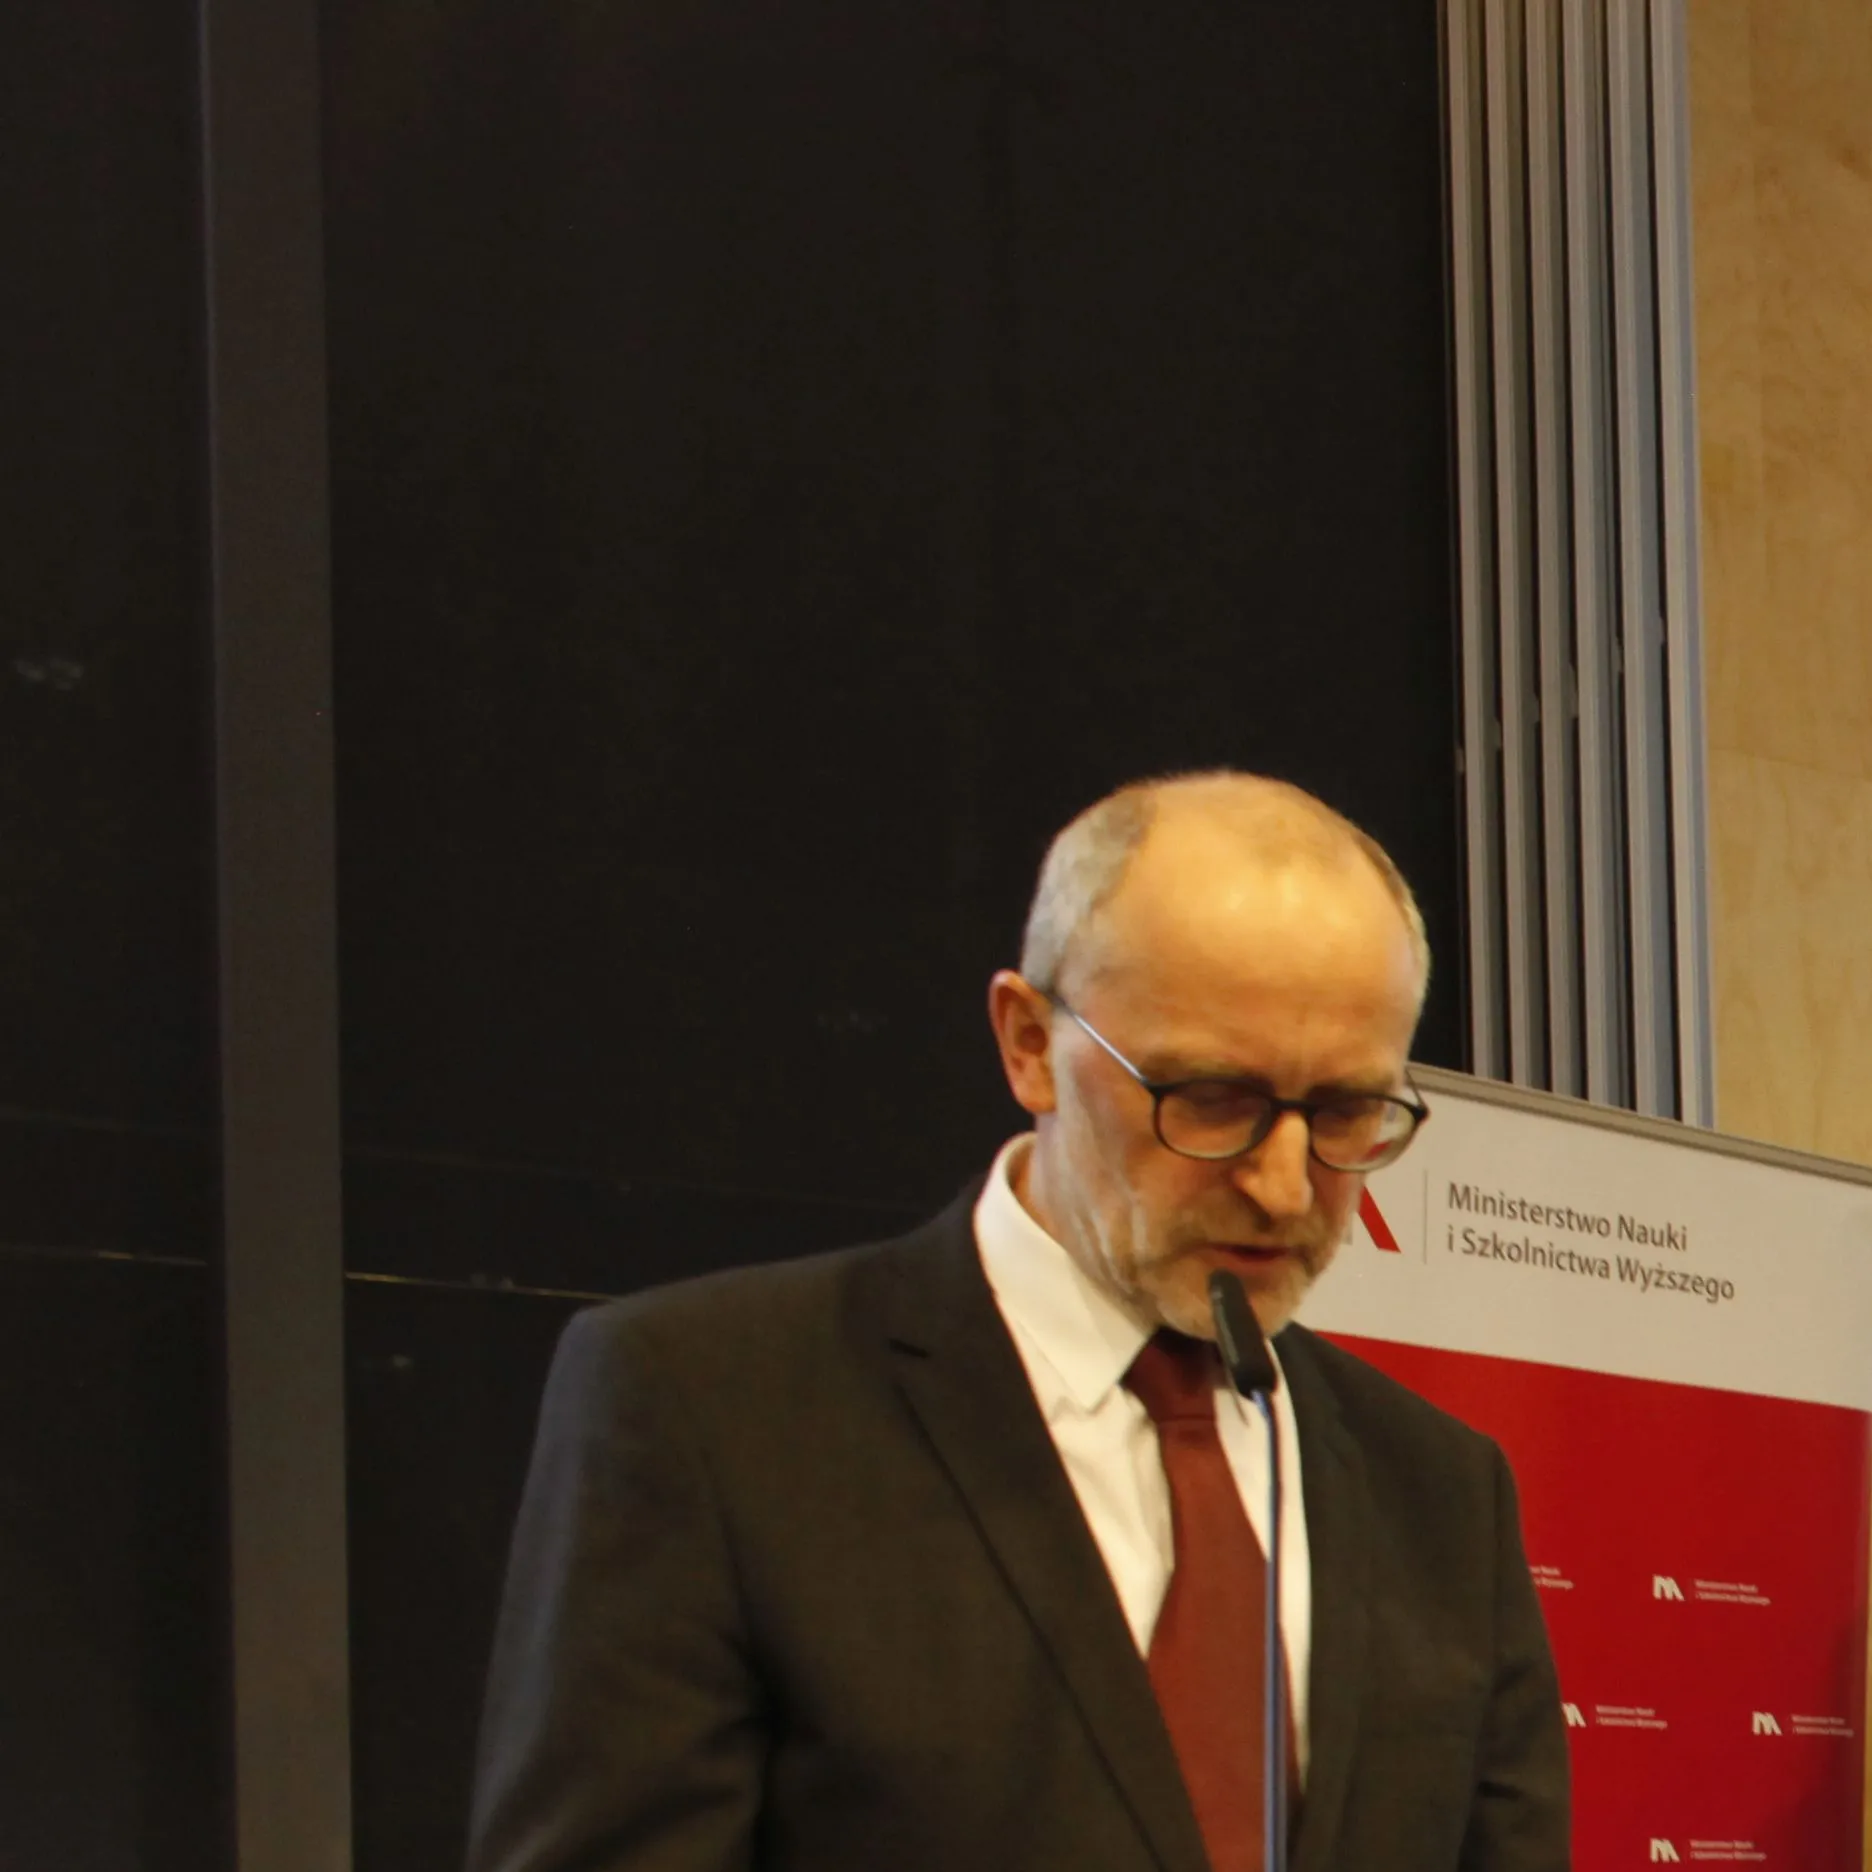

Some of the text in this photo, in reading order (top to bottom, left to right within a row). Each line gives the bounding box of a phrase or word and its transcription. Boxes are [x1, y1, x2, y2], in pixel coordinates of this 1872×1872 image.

[1447, 1181, 1688, 1252] Ministerstwo Nauki
[1446, 1225, 1736, 1304] i Szkolnictwa Wyższego
